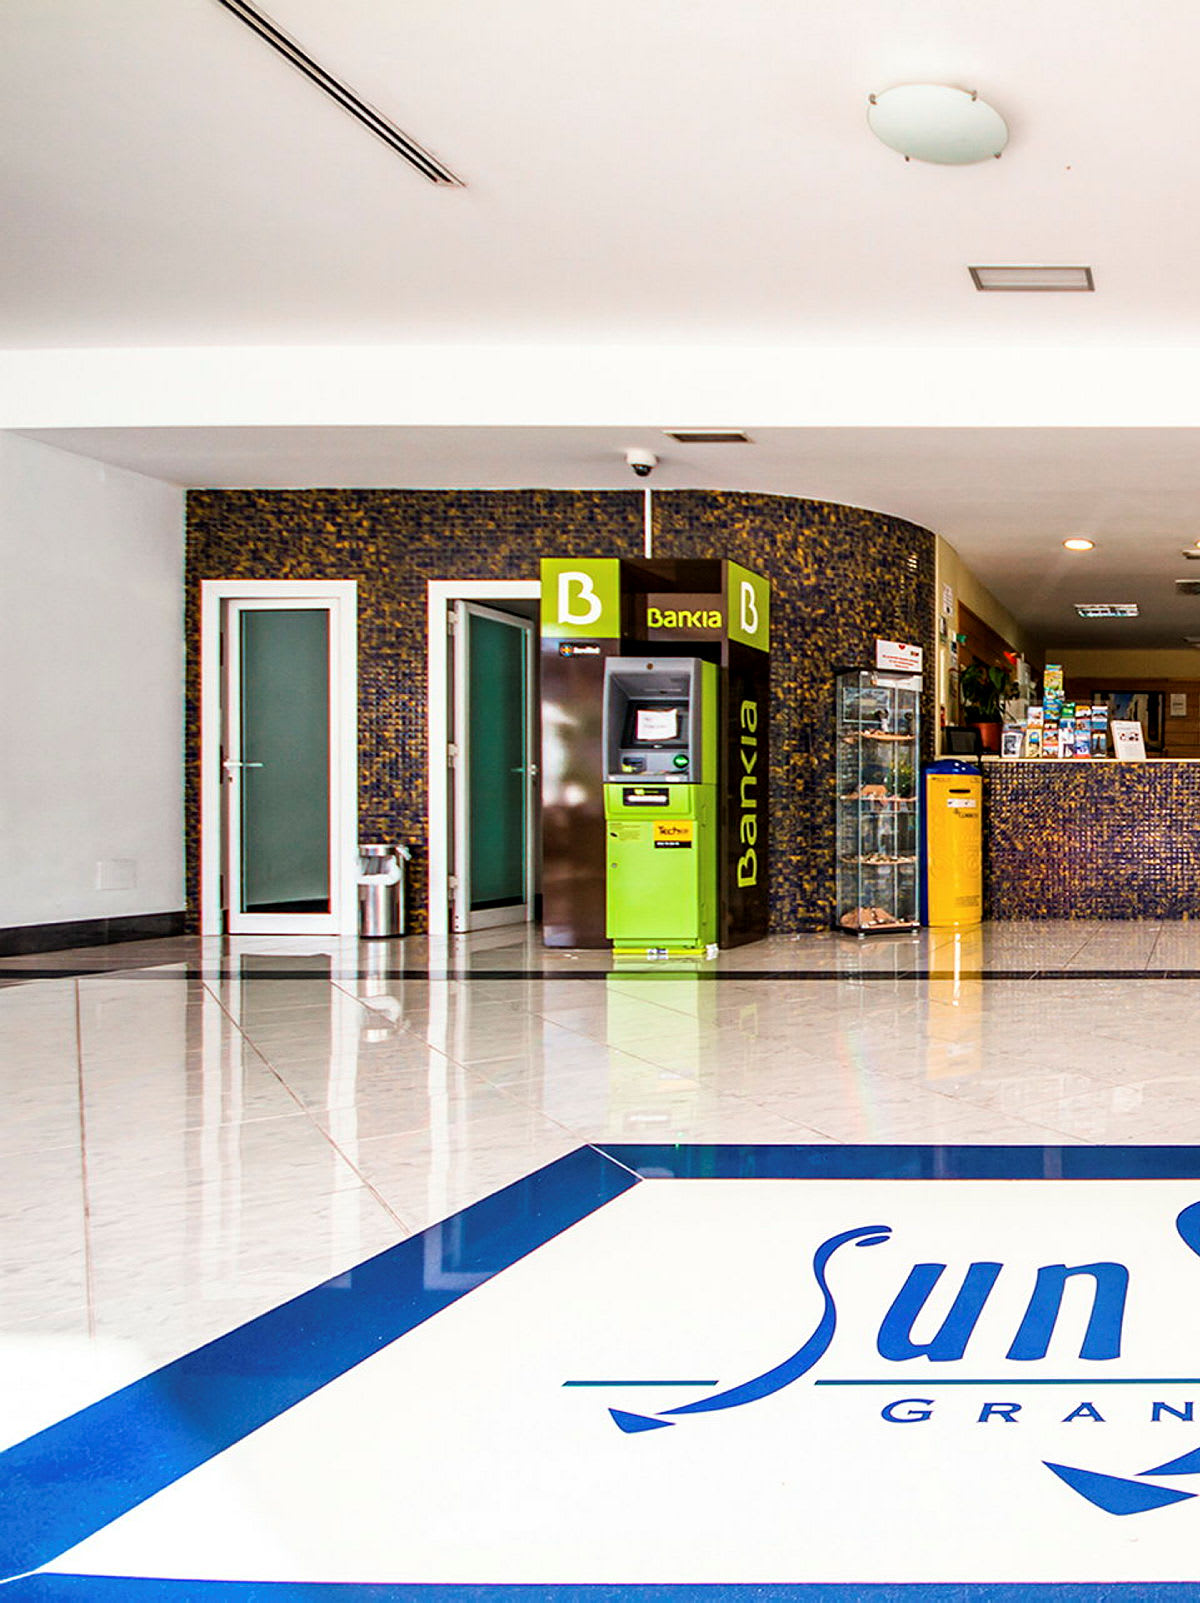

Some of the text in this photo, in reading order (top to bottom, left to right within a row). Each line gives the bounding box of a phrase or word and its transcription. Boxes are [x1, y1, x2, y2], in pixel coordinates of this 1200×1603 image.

[558, 571, 602, 625] B
[647, 607, 722, 628] Bankia
[741, 581, 758, 634] B
[737, 700, 757, 888] Bankia
[656, 1225, 1130, 1416] Sun
[880, 1398, 1196, 1423] GRAN
